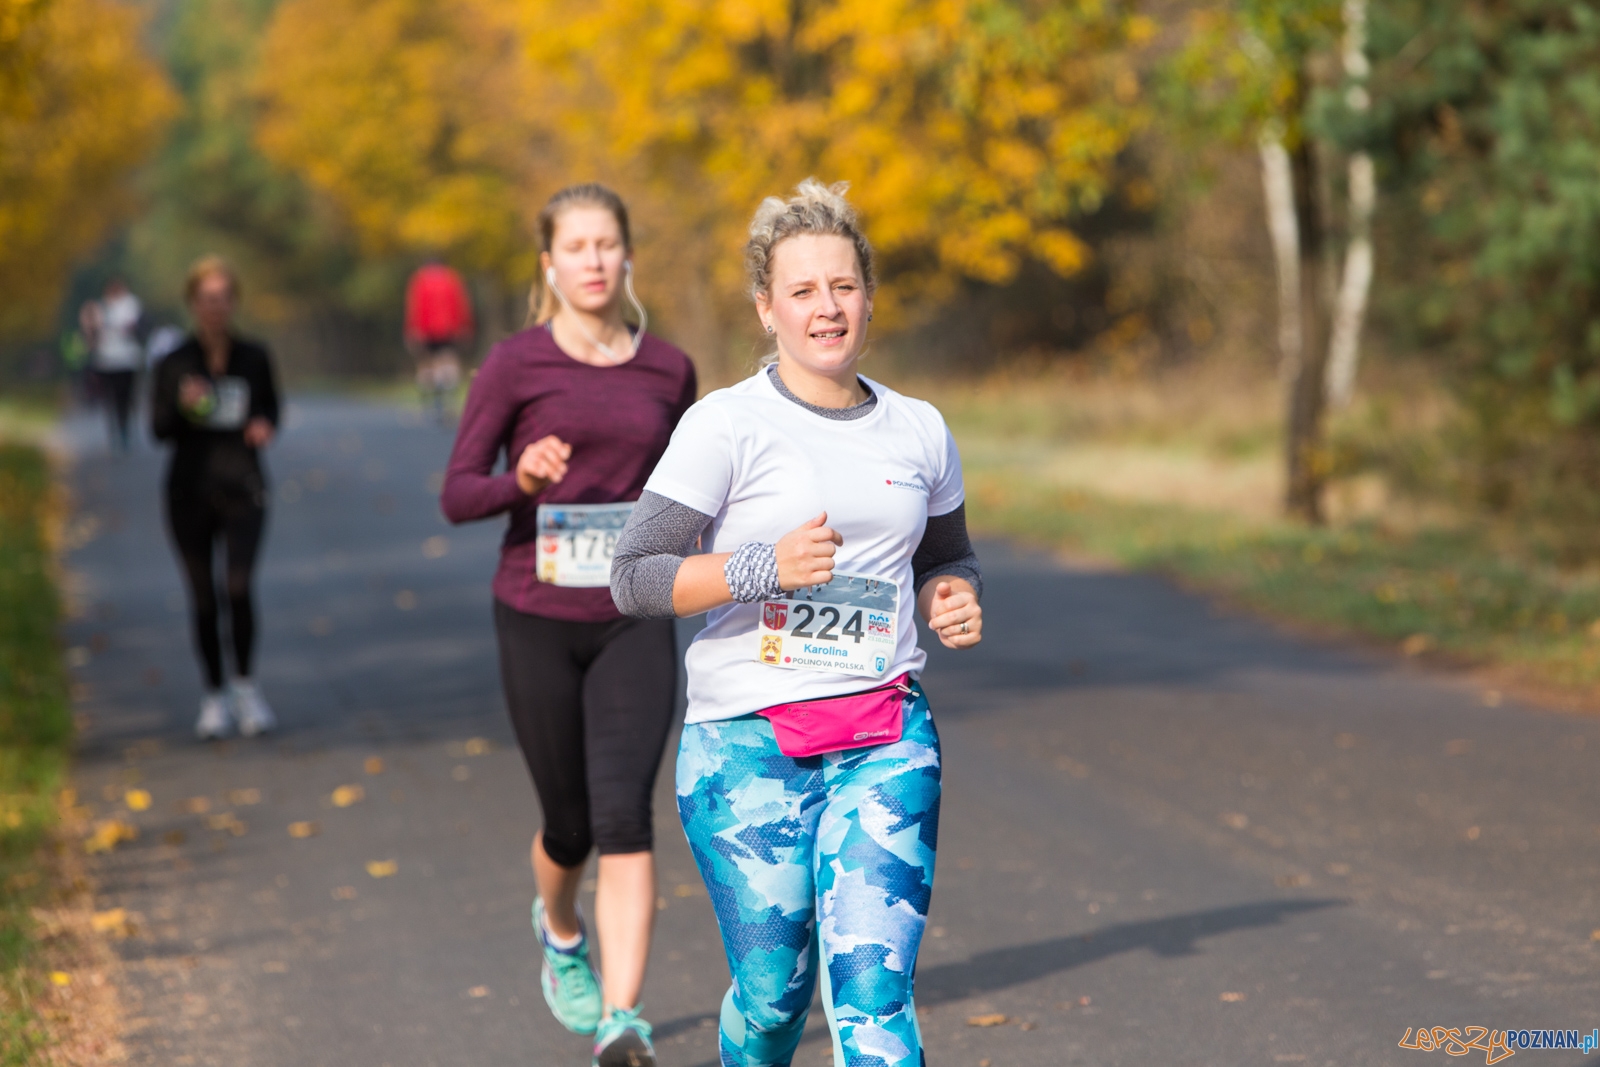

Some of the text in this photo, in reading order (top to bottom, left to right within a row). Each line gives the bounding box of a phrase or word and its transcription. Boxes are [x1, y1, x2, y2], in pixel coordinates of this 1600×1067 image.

[791, 604, 865, 643] 224
[804, 643, 848, 657] Karolina
[792, 657, 832, 668] POLINOVA
[834, 661, 865, 671] POLSKA
